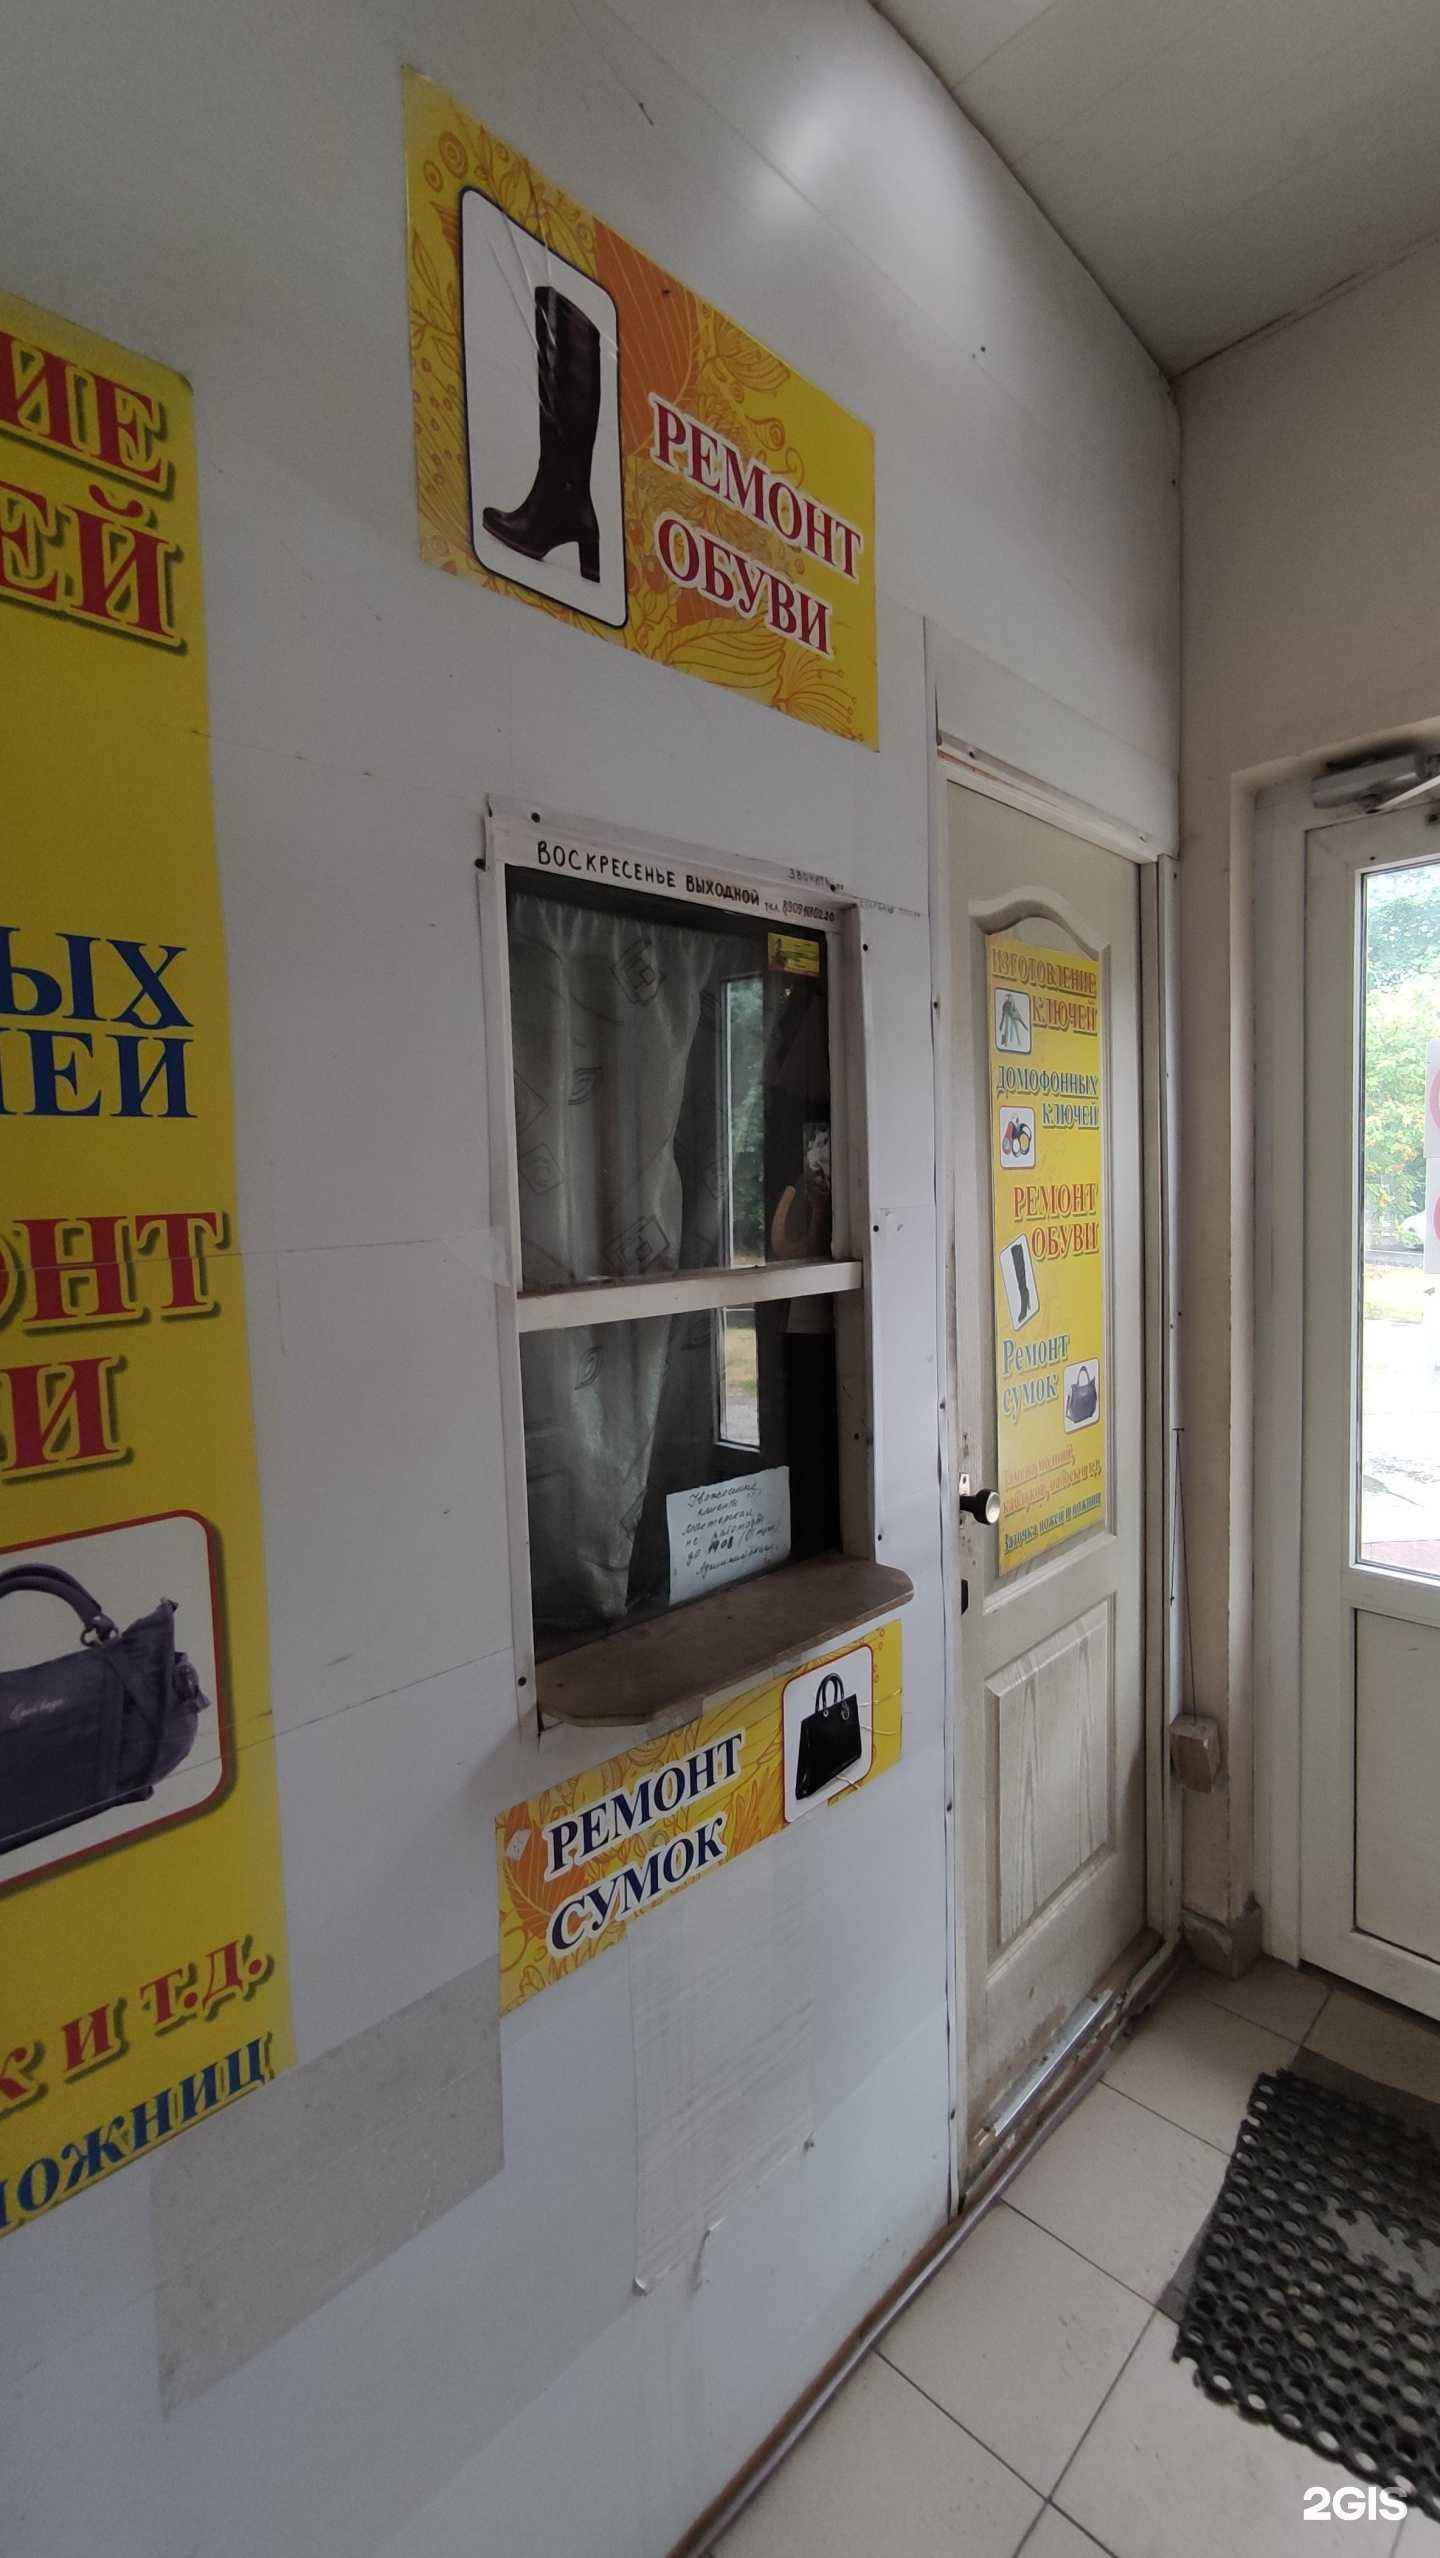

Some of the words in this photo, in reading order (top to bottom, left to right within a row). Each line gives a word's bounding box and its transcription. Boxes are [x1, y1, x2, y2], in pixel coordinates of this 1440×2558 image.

[652, 399, 862, 580] РЕМОНТ
[657, 517, 831, 656] ОБУВИ
[536, 839, 677, 888] ВОСКРЕСЕНЬЕ
[685, 875, 759, 906] ВЫХОДНОЙ
[991, 948, 1097, 996] ИЗГОТОВЛЕНИЕ
[1031, 996, 1098, 1032] КЛЮЧЕЙ
[0, 1027, 198, 1119] ЕЙ
[997, 1065, 1099, 1096] ДОМОФОННЫХ
[1042, 1102, 1099, 1128] КЛЮЧЕЙ
[1013, 1183, 1098, 1219] РЕМОНТ
[1031, 1221, 1099, 1260] ОБУВИ
[0, 1211, 226, 1325] НТ
[1002, 1335, 1070, 1376] Ремонт
[1002, 1374, 1058, 1421] сумок
[549, 1733, 742, 1874] РЕМОНТ
[551, 1816, 724, 1951] СУМОК
